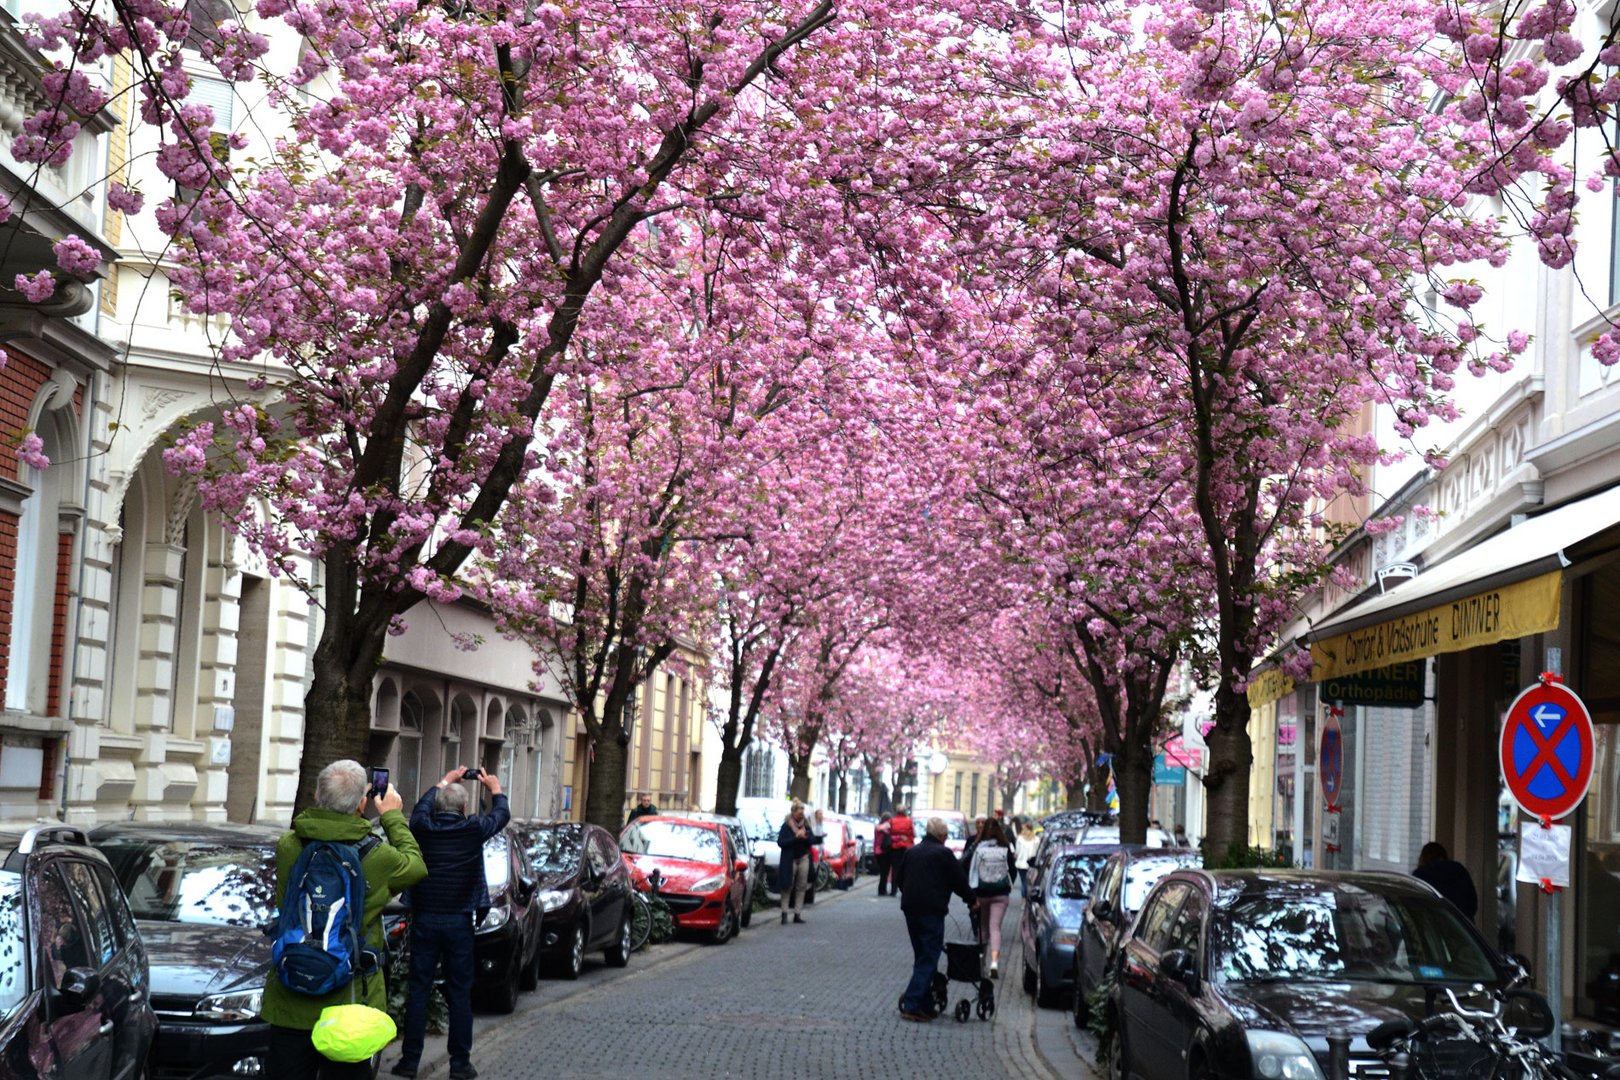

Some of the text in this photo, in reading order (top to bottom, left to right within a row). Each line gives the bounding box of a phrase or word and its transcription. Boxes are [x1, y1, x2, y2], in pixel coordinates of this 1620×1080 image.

[1377, 625, 1385, 658] &
[1452, 592, 1500, 640] DINTNER
[1344, 663, 1419, 681] NTNER
[1327, 682, 1419, 702] Orthopädie
